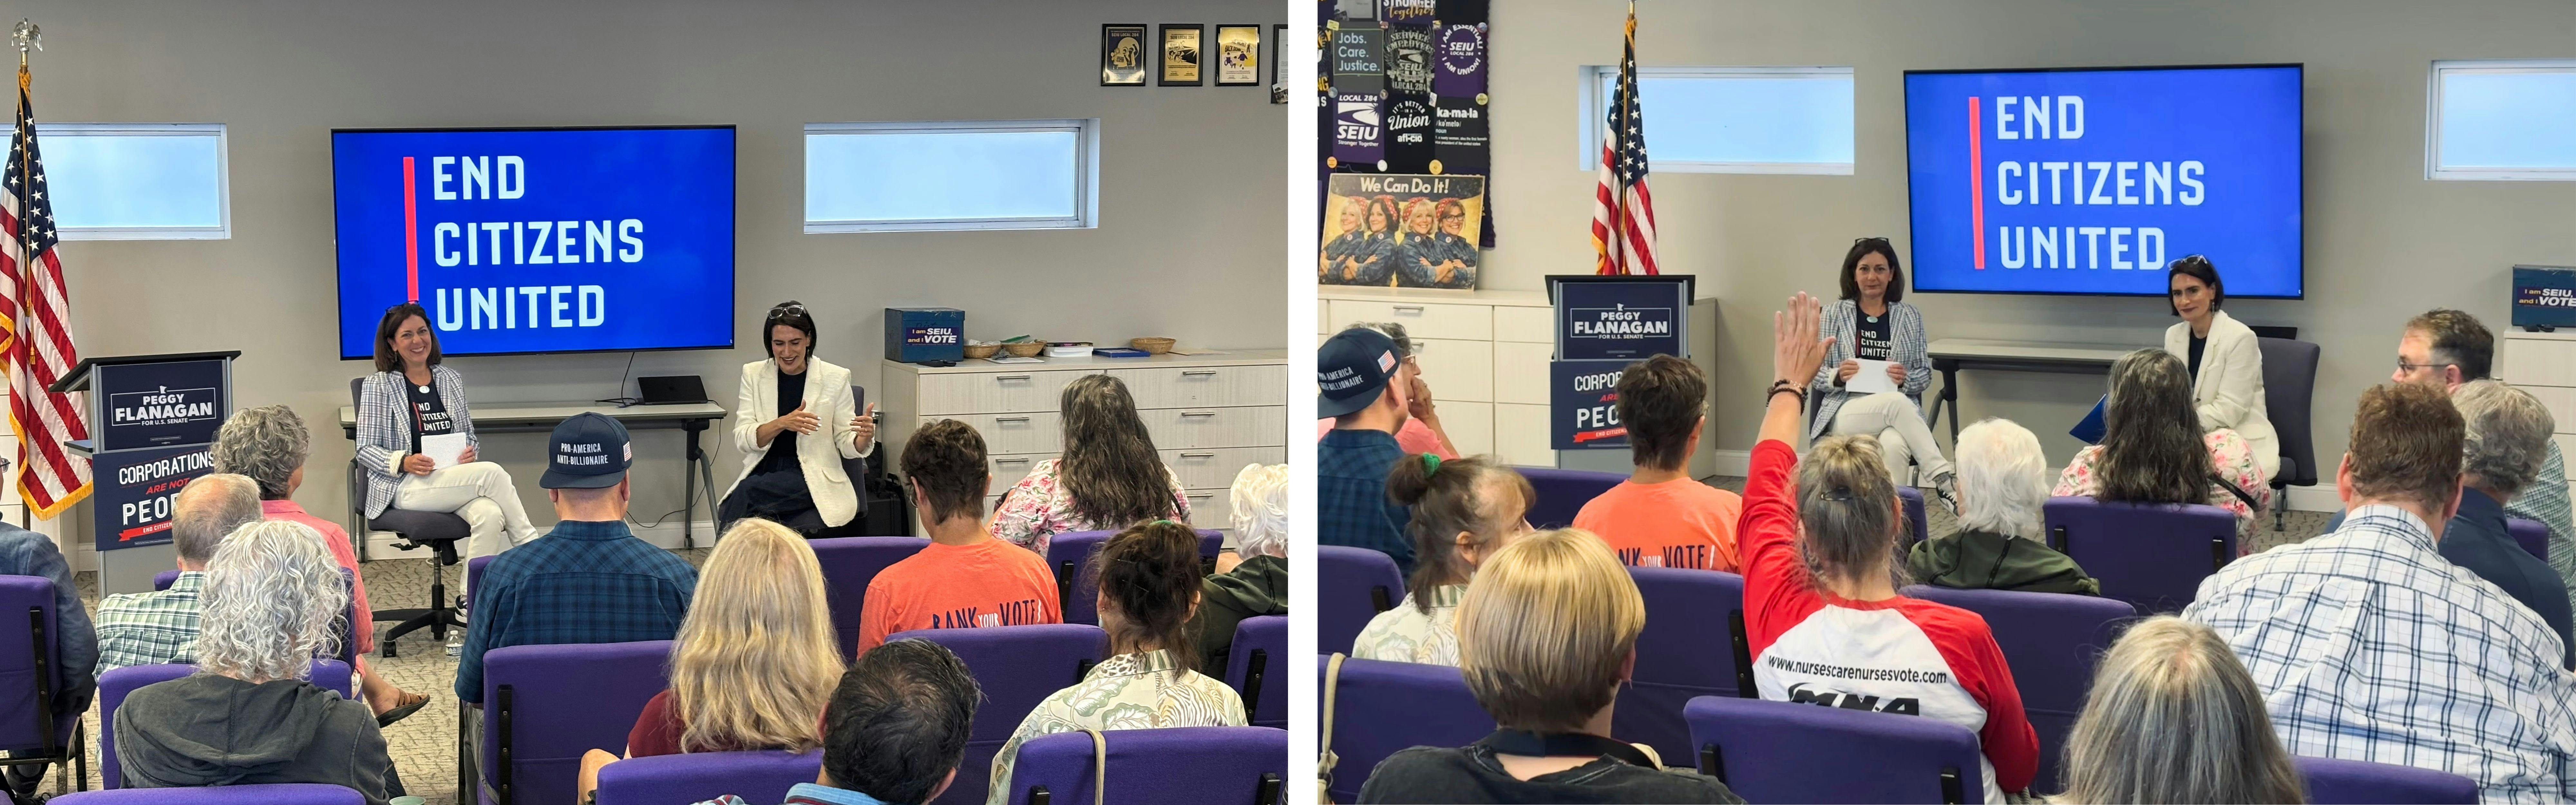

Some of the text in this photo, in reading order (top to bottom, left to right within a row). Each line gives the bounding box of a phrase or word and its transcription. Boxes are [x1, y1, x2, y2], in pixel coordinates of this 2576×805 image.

[1338, 33, 1367, 43] Jobs.
[1443, 29, 1452, 43] AM
[1339, 46, 1369, 57] Care.
[1449, 42, 1474, 51] SEIU
[1339, 60, 1380, 71] Justice.
[1399, 62, 1423, 72] SEIU
[1444, 62, 1456, 73] AM
[1392, 100, 1425, 114] IT'S BETTER
[1387, 113, 1431, 130] Union
[1996, 96, 2084, 139] END
[1337, 125, 1379, 140] SEIU
[433, 156, 525, 200] END
[1998, 161, 2205, 205] CITIZENS
[1360, 177, 1449, 194] We Can Do It!
[434, 219, 643, 267] CITIZENS
[2000, 226, 2165, 270] UNITED
[2542, 289, 2573, 298] SEIU,
[2539, 296, 2576, 307] VOTE
[437, 285, 604, 331] UNITED
[1601, 312, 1640, 321] PEGGY
[1574, 321, 1668, 334] FLANAGAN
[924, 335, 957, 343] VOTE
[1861, 338, 1891, 347] CITIZEN
[1861, 347, 1891, 357] UNITED
[143, 393, 185, 405] PEGGY
[115, 402, 213, 422] FLANAGAN
[420, 412, 448, 421] CITIZEN
[1577, 404, 1619, 428] PEO
[424, 421, 451, 431] UNITED
[561, 443, 601, 453] PRO-AMERICA
[557, 454, 608, 465] ANTI-BILLIONAIRE
[146, 478, 190, 495] ARE NOT
[154, 522, 173, 531] CITIZEN
[1642, 555, 1662, 568] YOUR
[978, 612, 1000, 628] YOUR
[1768, 655, 1947, 683] www.nursescarenursesvote.com
